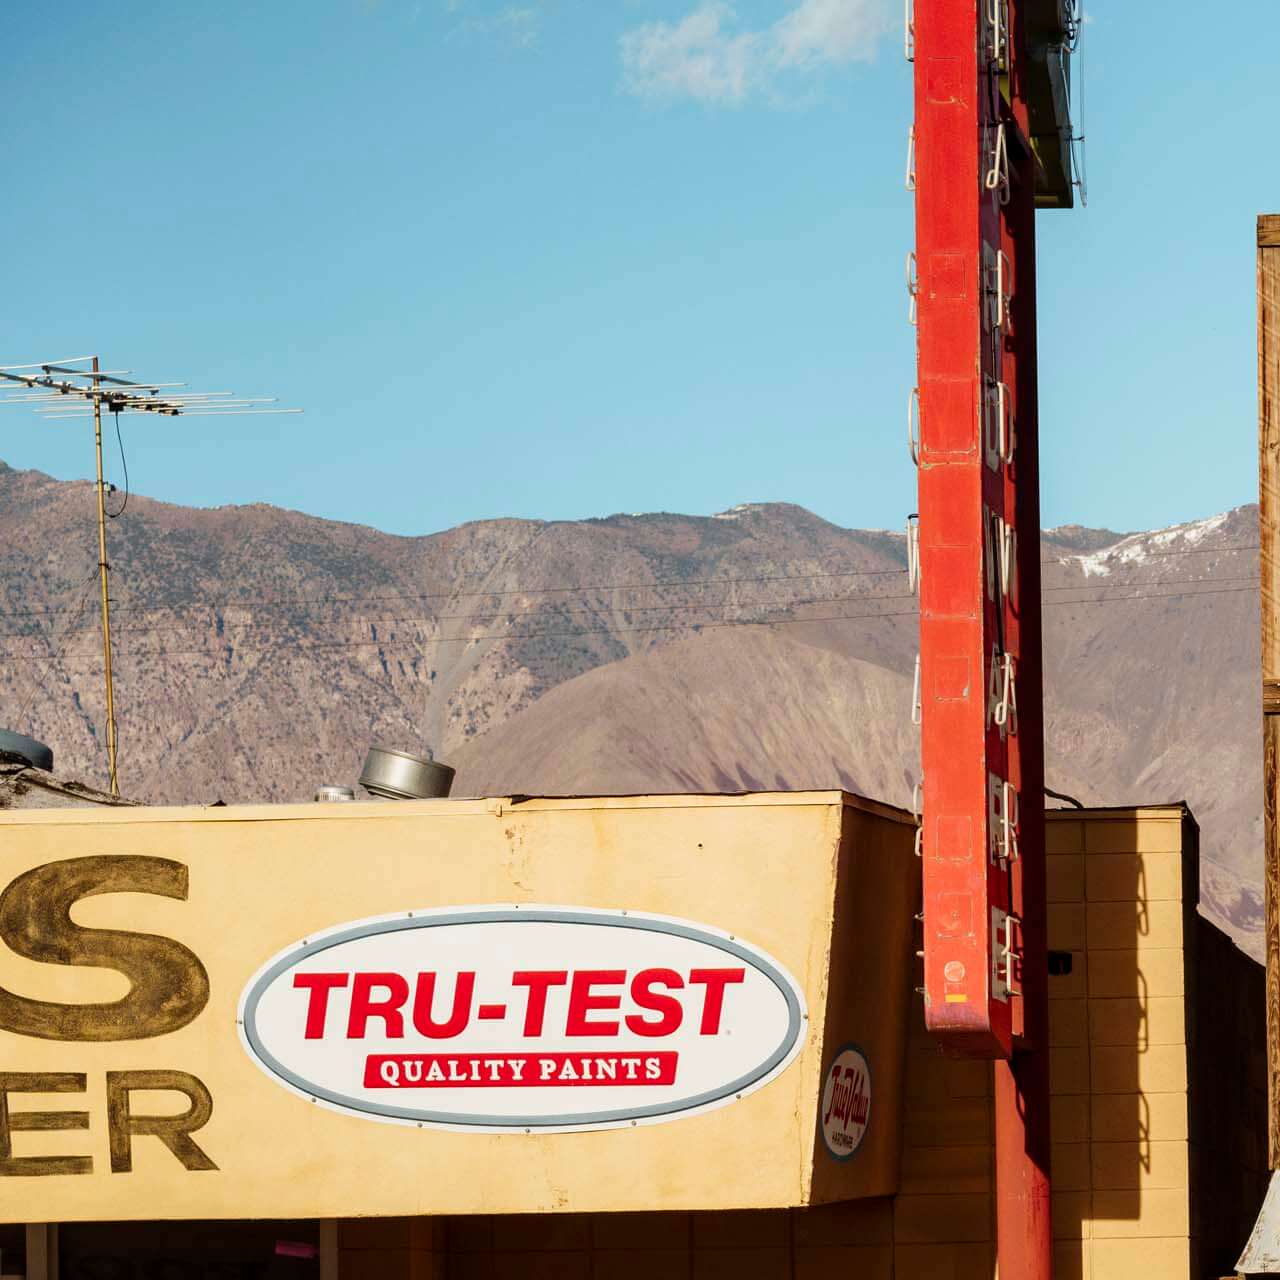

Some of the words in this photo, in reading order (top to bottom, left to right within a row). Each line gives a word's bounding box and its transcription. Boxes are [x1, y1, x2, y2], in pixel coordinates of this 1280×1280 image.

[0, 855, 210, 1041] S
[294, 968, 744, 1039] TRU-TEST
[379, 1059, 525, 1084] QUALITY
[539, 1057, 662, 1081] PAINTS
[0, 1069, 220, 1176] ER
